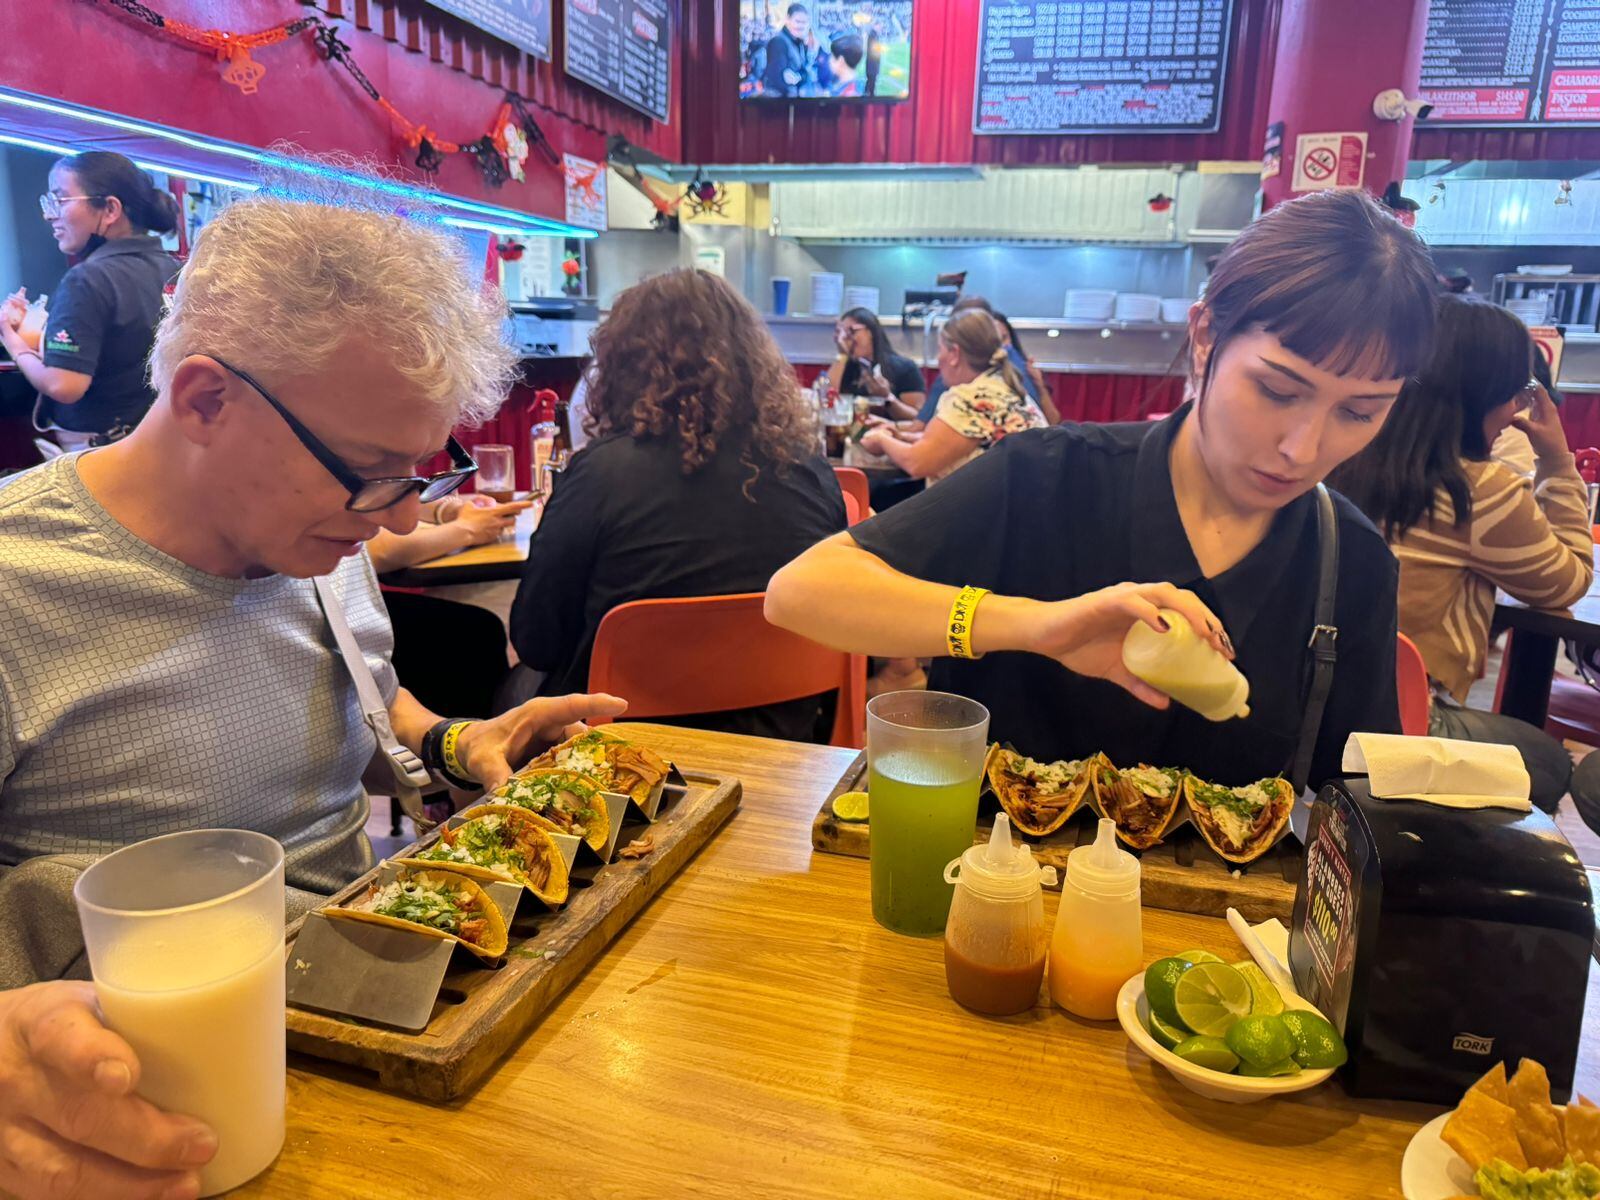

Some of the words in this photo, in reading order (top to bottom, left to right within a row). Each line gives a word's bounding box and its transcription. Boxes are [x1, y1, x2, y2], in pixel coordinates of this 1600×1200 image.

[1315, 863, 1326, 889] CON
[1326, 883, 1343, 921] QUESO
[1317, 850, 1345, 906] ALAMBRES
[1455, 1038, 1489, 1052] TORK
